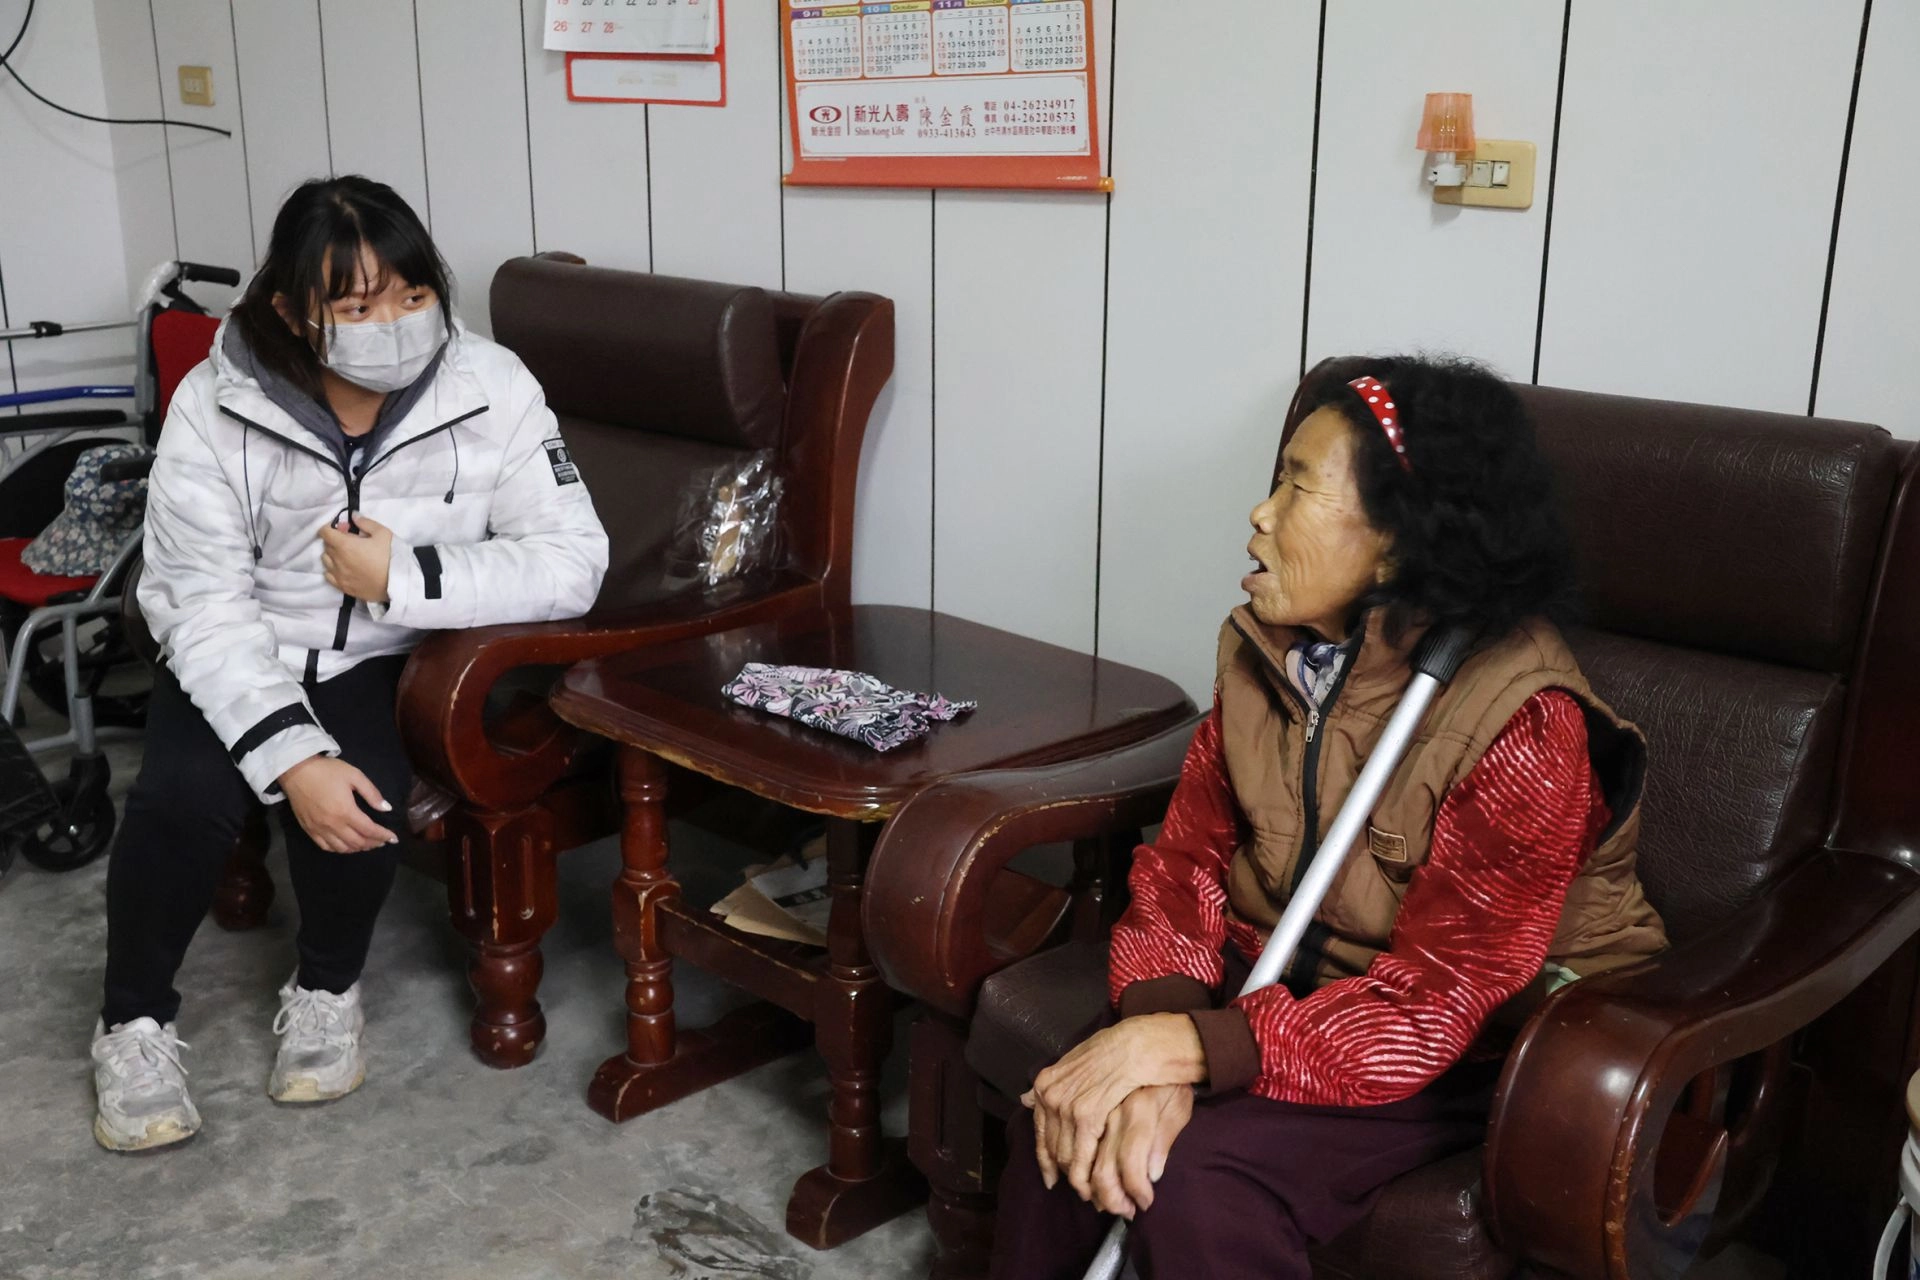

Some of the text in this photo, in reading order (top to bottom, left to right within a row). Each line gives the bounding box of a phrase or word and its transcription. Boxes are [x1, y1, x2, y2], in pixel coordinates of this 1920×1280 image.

[553, 20, 614, 33] 26 27 28
[1004, 99, 1075, 110] 04-26234917
[854, 104, 909, 123] 新光人壽
[1004, 112, 1075, 123] 04-26220573
